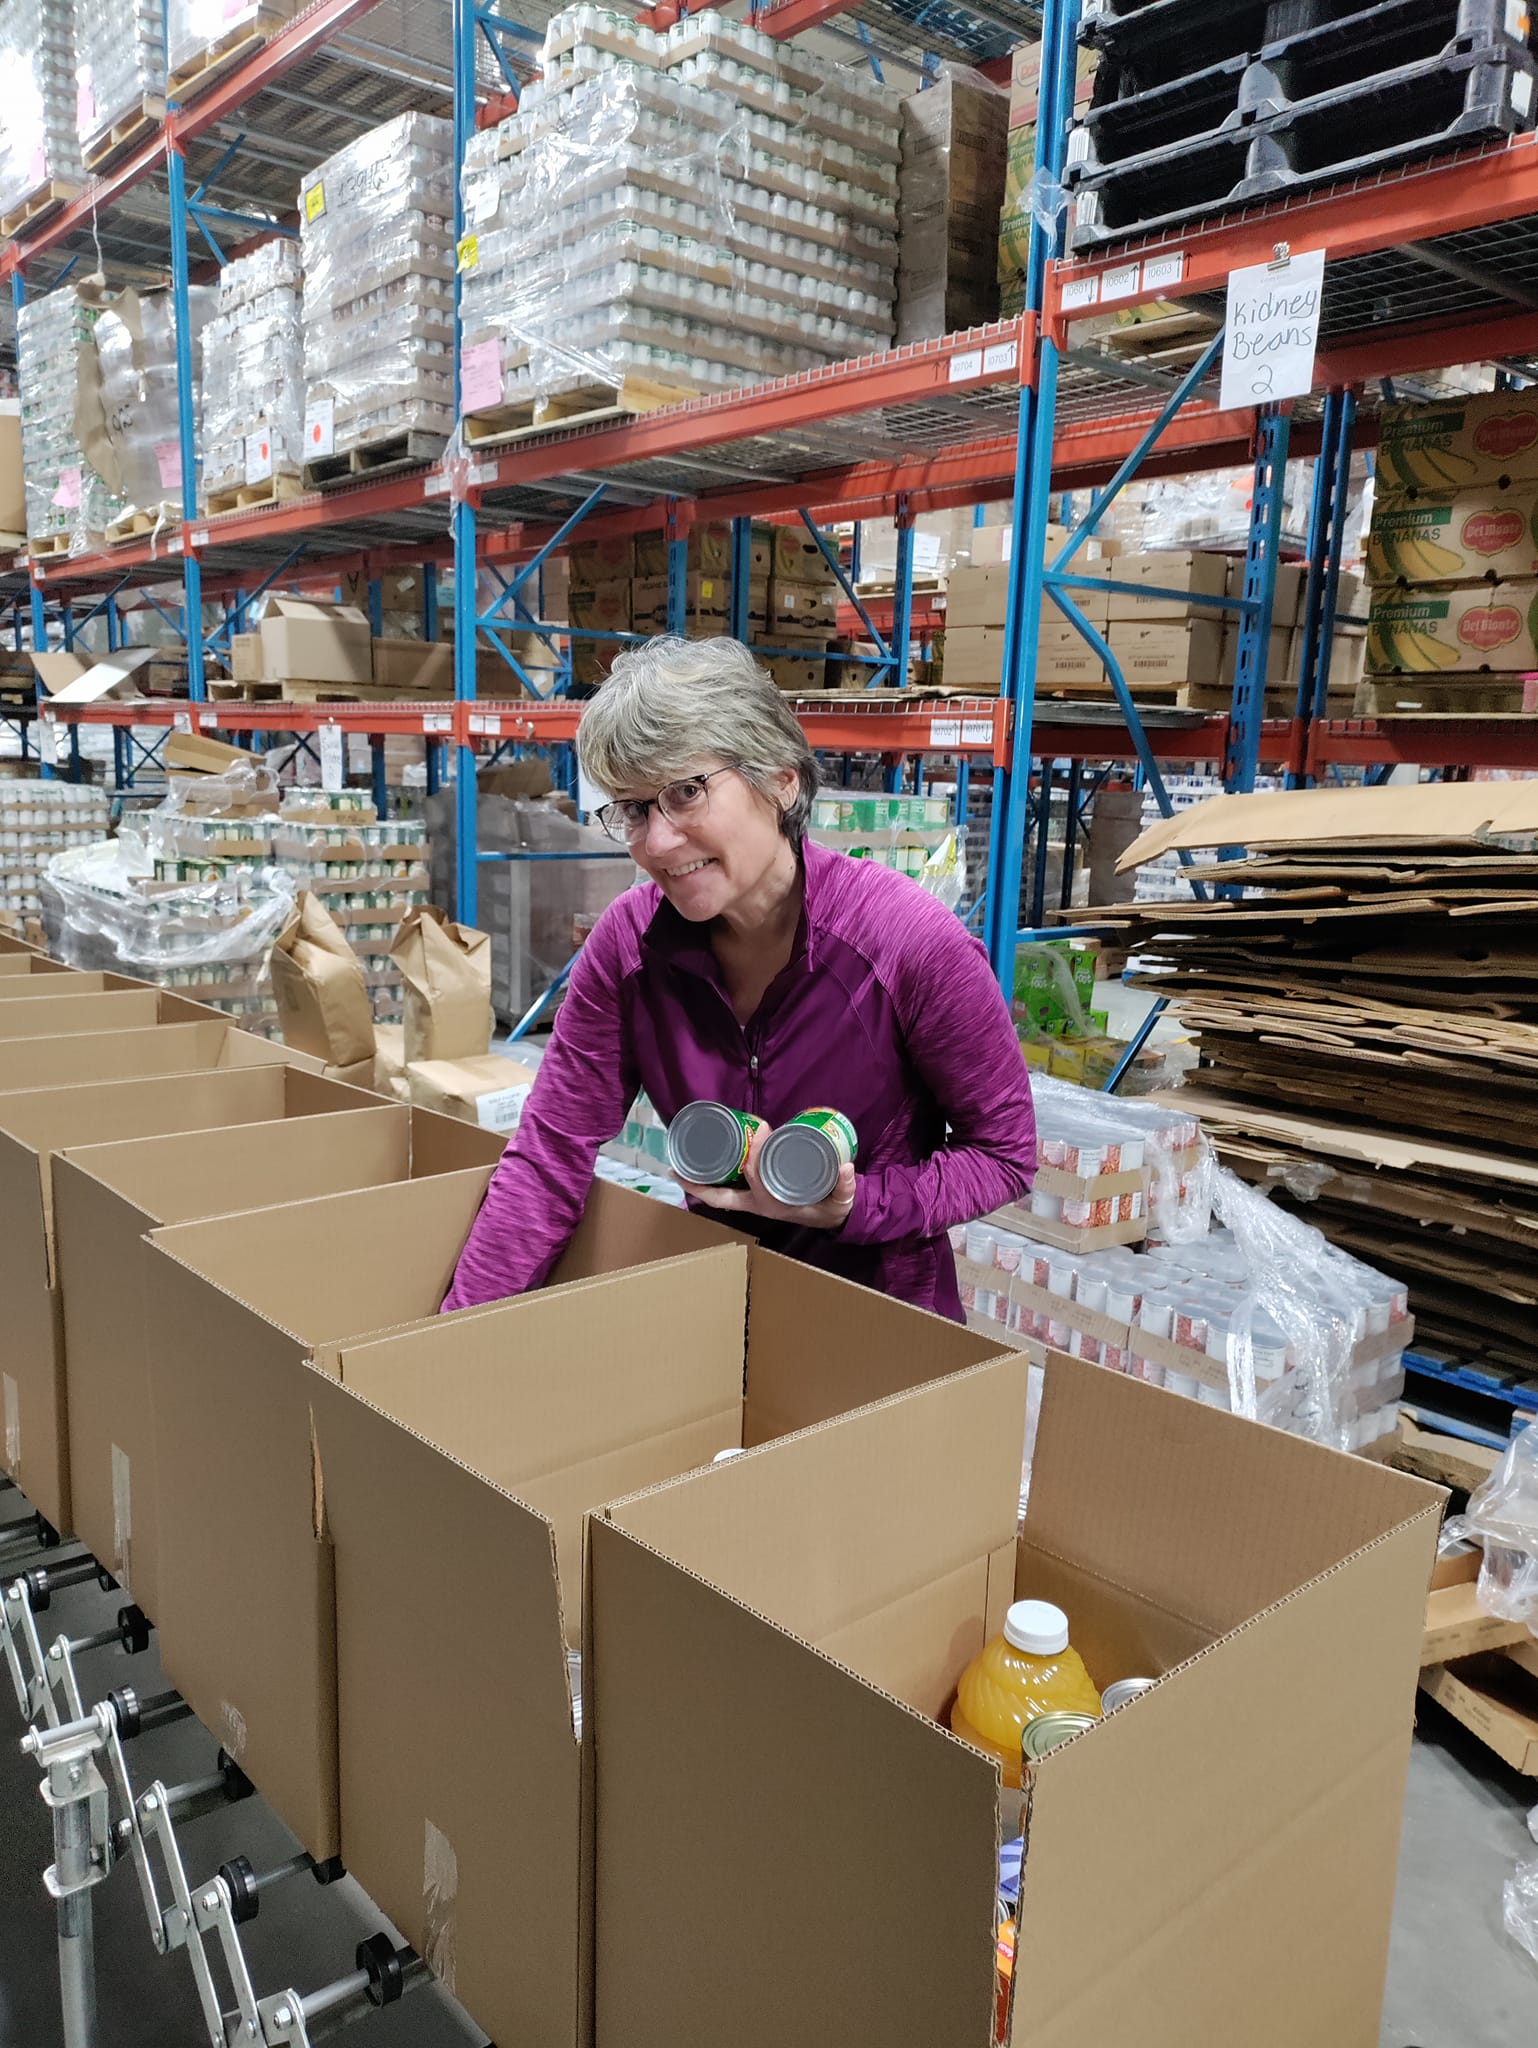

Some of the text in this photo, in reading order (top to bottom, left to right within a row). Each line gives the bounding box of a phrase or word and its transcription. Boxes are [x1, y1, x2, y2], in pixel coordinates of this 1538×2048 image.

[1234, 290, 1317, 327] Kidney
[1233, 326, 1312, 360] Beans
[1251, 364, 1274, 395] 2
[1375, 511, 1433, 529] Premium
[1373, 605, 1431, 619] Premium
